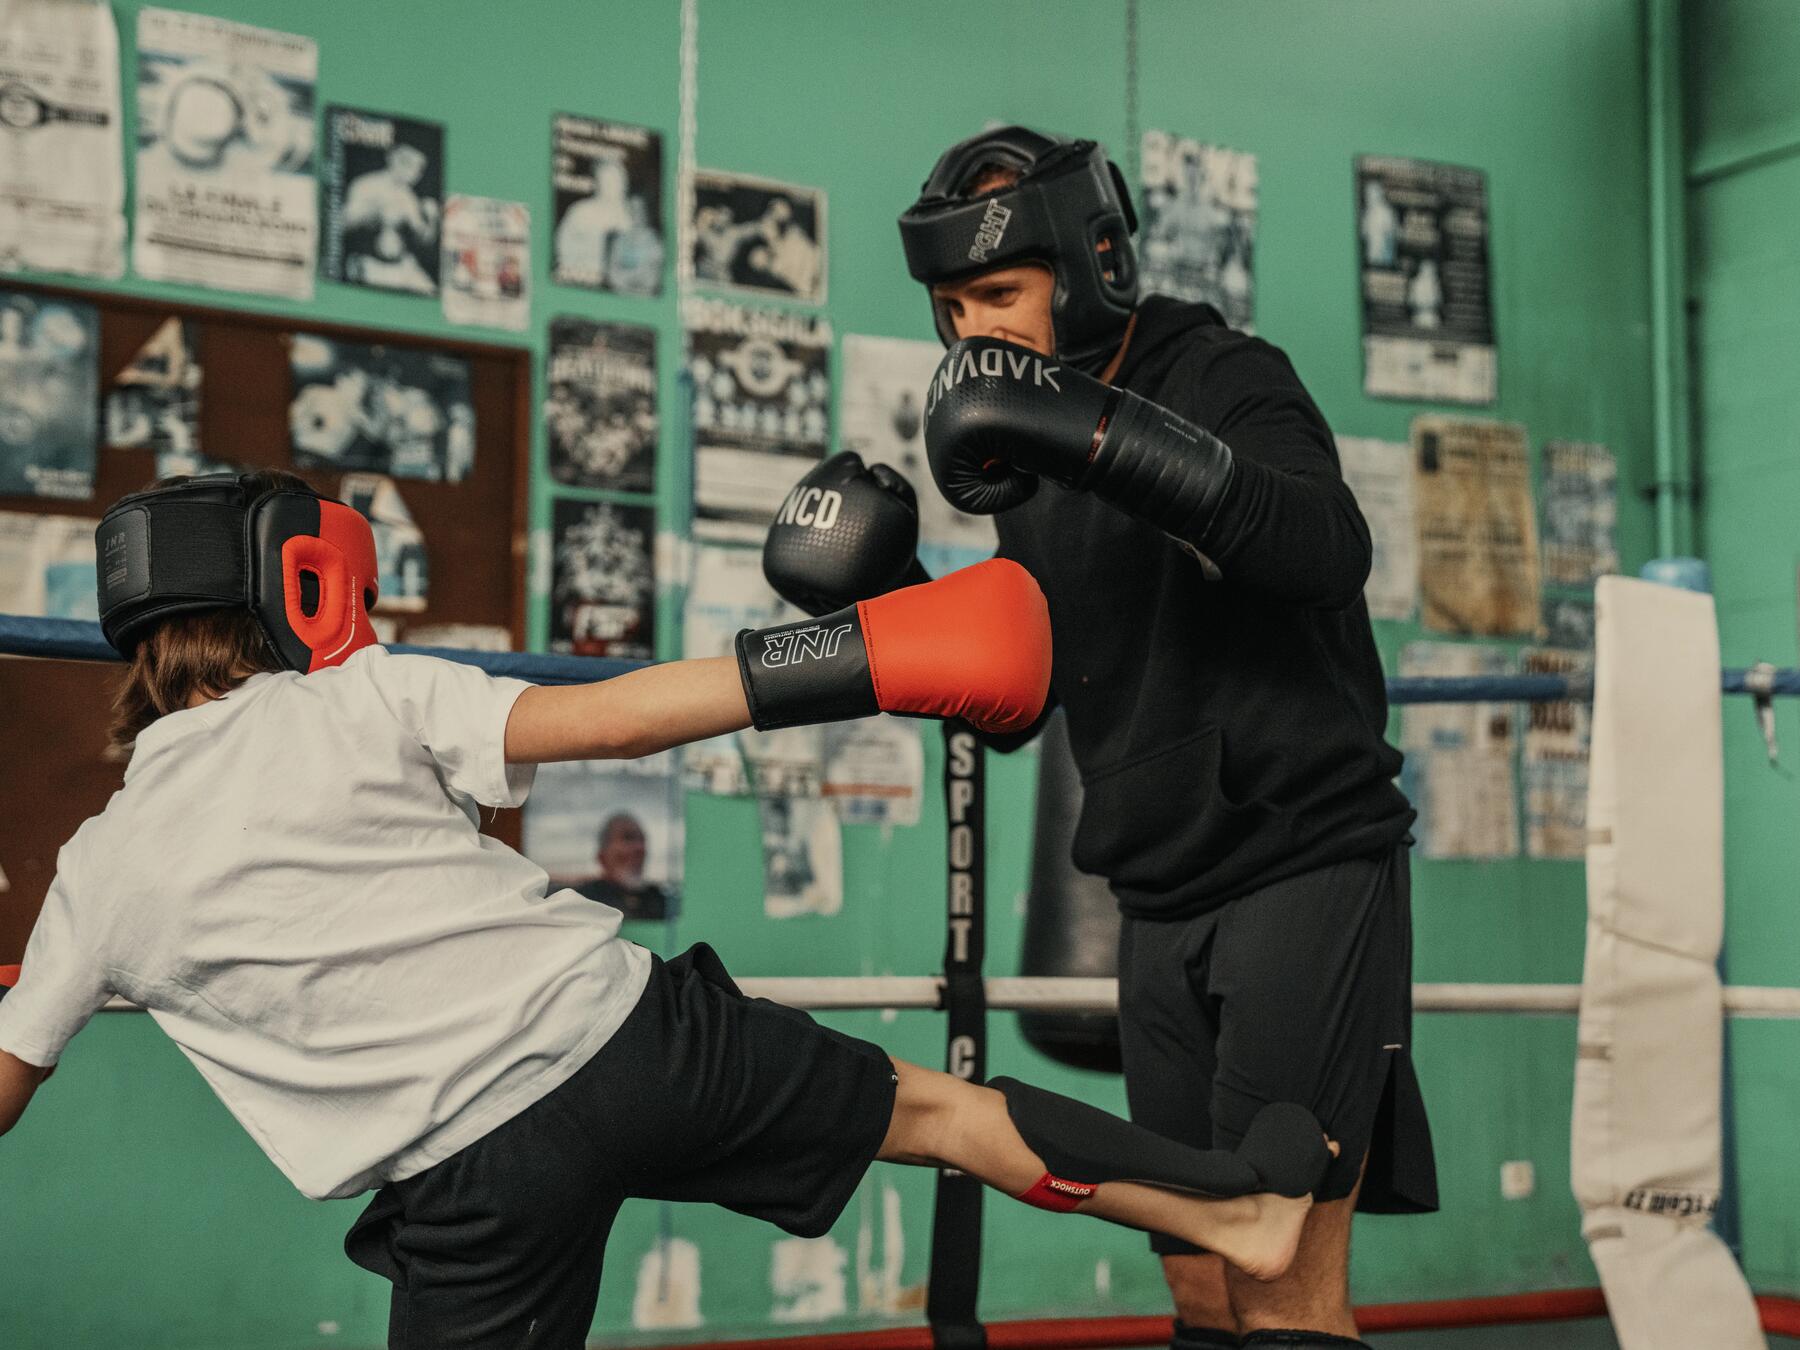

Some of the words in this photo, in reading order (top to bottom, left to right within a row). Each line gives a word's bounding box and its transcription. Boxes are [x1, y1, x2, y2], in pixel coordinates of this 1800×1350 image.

[762, 624, 852, 668] JNR
[949, 732, 975, 963] SPORT
[1051, 1180, 1091, 1196] OUTSHOCK
